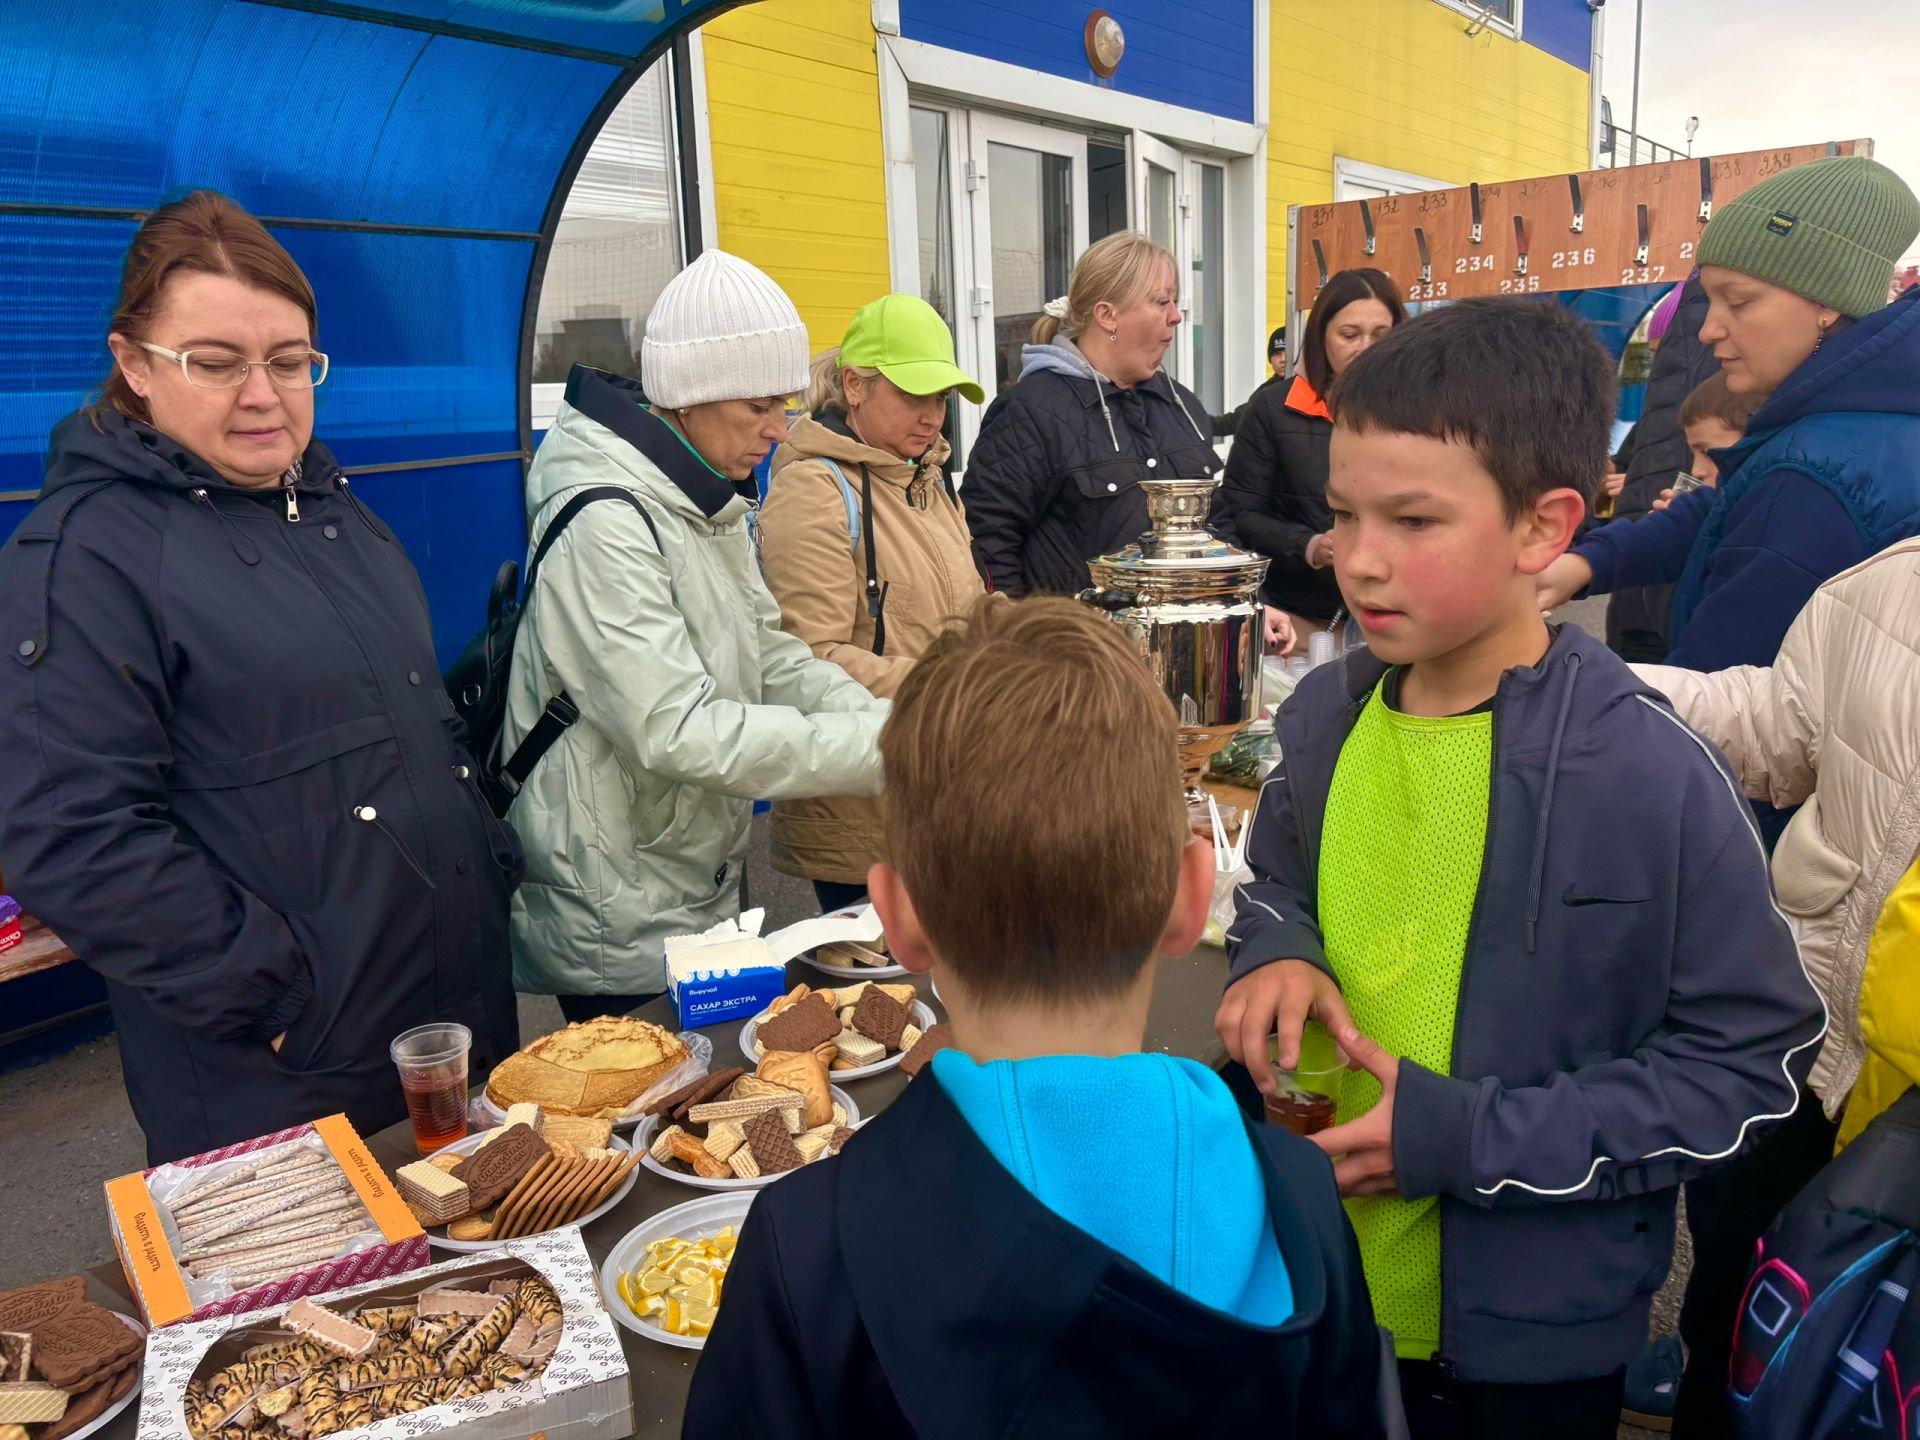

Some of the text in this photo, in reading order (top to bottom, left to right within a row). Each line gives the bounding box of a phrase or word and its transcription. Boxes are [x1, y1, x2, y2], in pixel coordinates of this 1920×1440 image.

[1455, 254, 1494, 274] 234
[1551, 248, 1595, 269] 236
[1621, 266, 1665, 285] 237
[1409, 281, 1448, 300] 233
[1500, 276, 1540, 295] 235
[690, 1001, 721, 1012] САХАР
[722, 995, 757, 1007] ЭКСТРА
